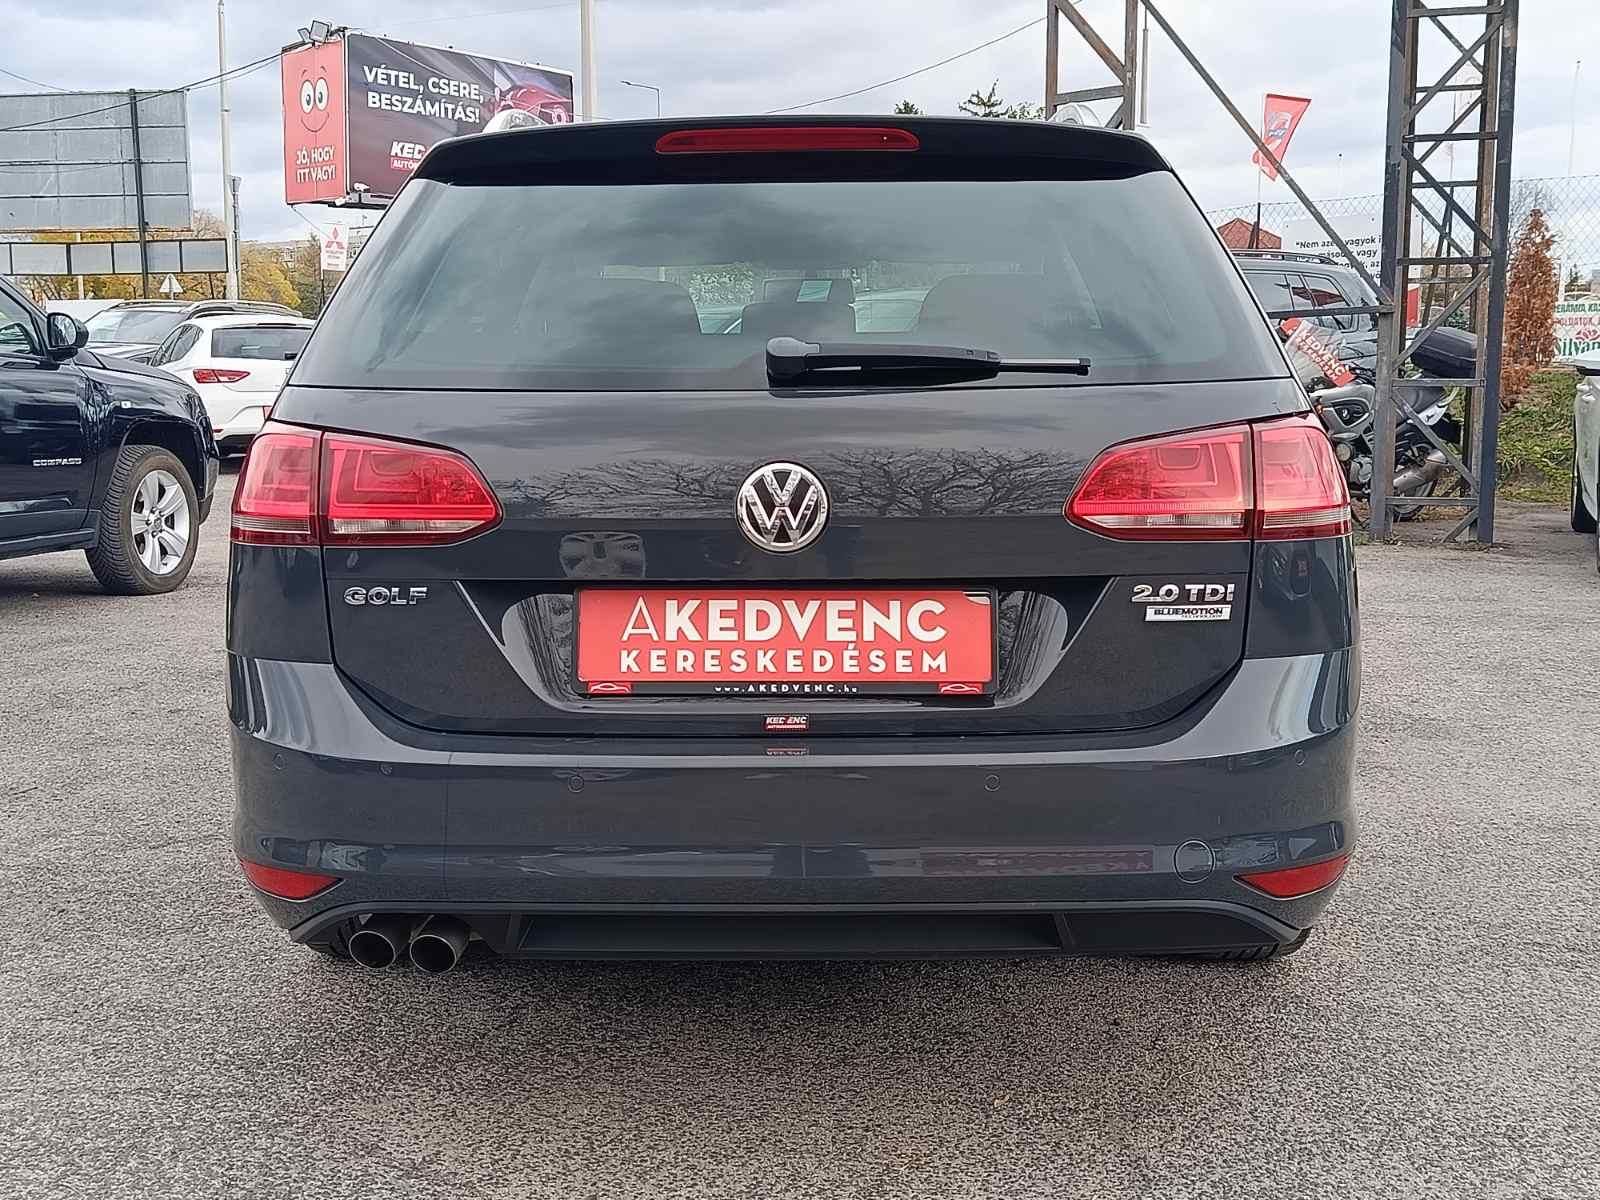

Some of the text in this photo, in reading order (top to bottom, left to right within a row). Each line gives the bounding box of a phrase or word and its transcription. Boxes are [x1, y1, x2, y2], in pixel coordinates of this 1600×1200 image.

[363, 65, 484, 104] VÉTEL, CSERE,
[367, 91, 480, 123] BESZÁMÍTÁS!
[296, 145, 335, 167] JÓ, HOGY
[296, 165, 336, 183] ITT VAGY!
[344, 586, 427, 605] GOLF
[1131, 583, 1235, 602] 2.0 TDI
[620, 642, 948, 673] KERESKEDÉSEM
[714, 683, 858, 693] www.AKEDVENC.hu
